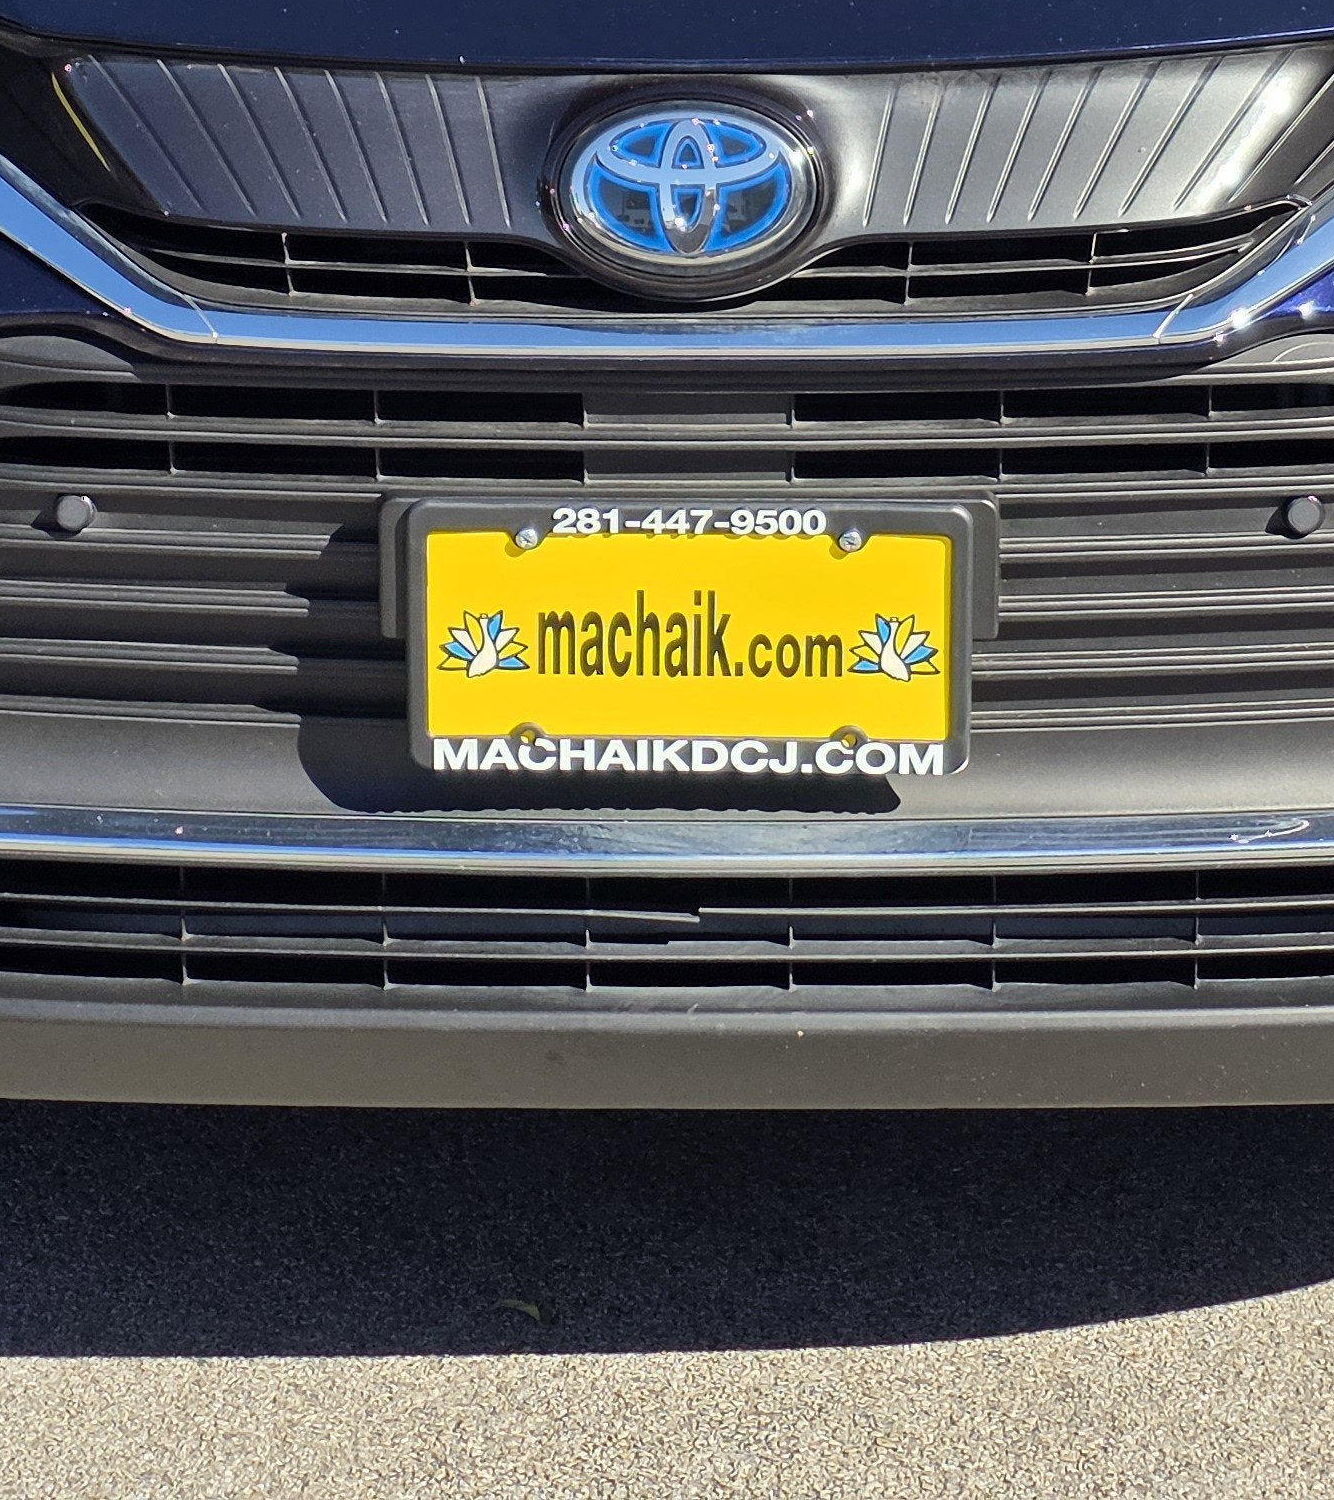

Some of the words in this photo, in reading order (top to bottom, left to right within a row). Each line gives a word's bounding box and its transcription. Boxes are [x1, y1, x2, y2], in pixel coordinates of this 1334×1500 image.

[552, 507, 826, 536] 281-447-9500
[537, 589, 844, 678] machaik.com
[433, 737, 944, 777] MACHAIKDCJ.COM
